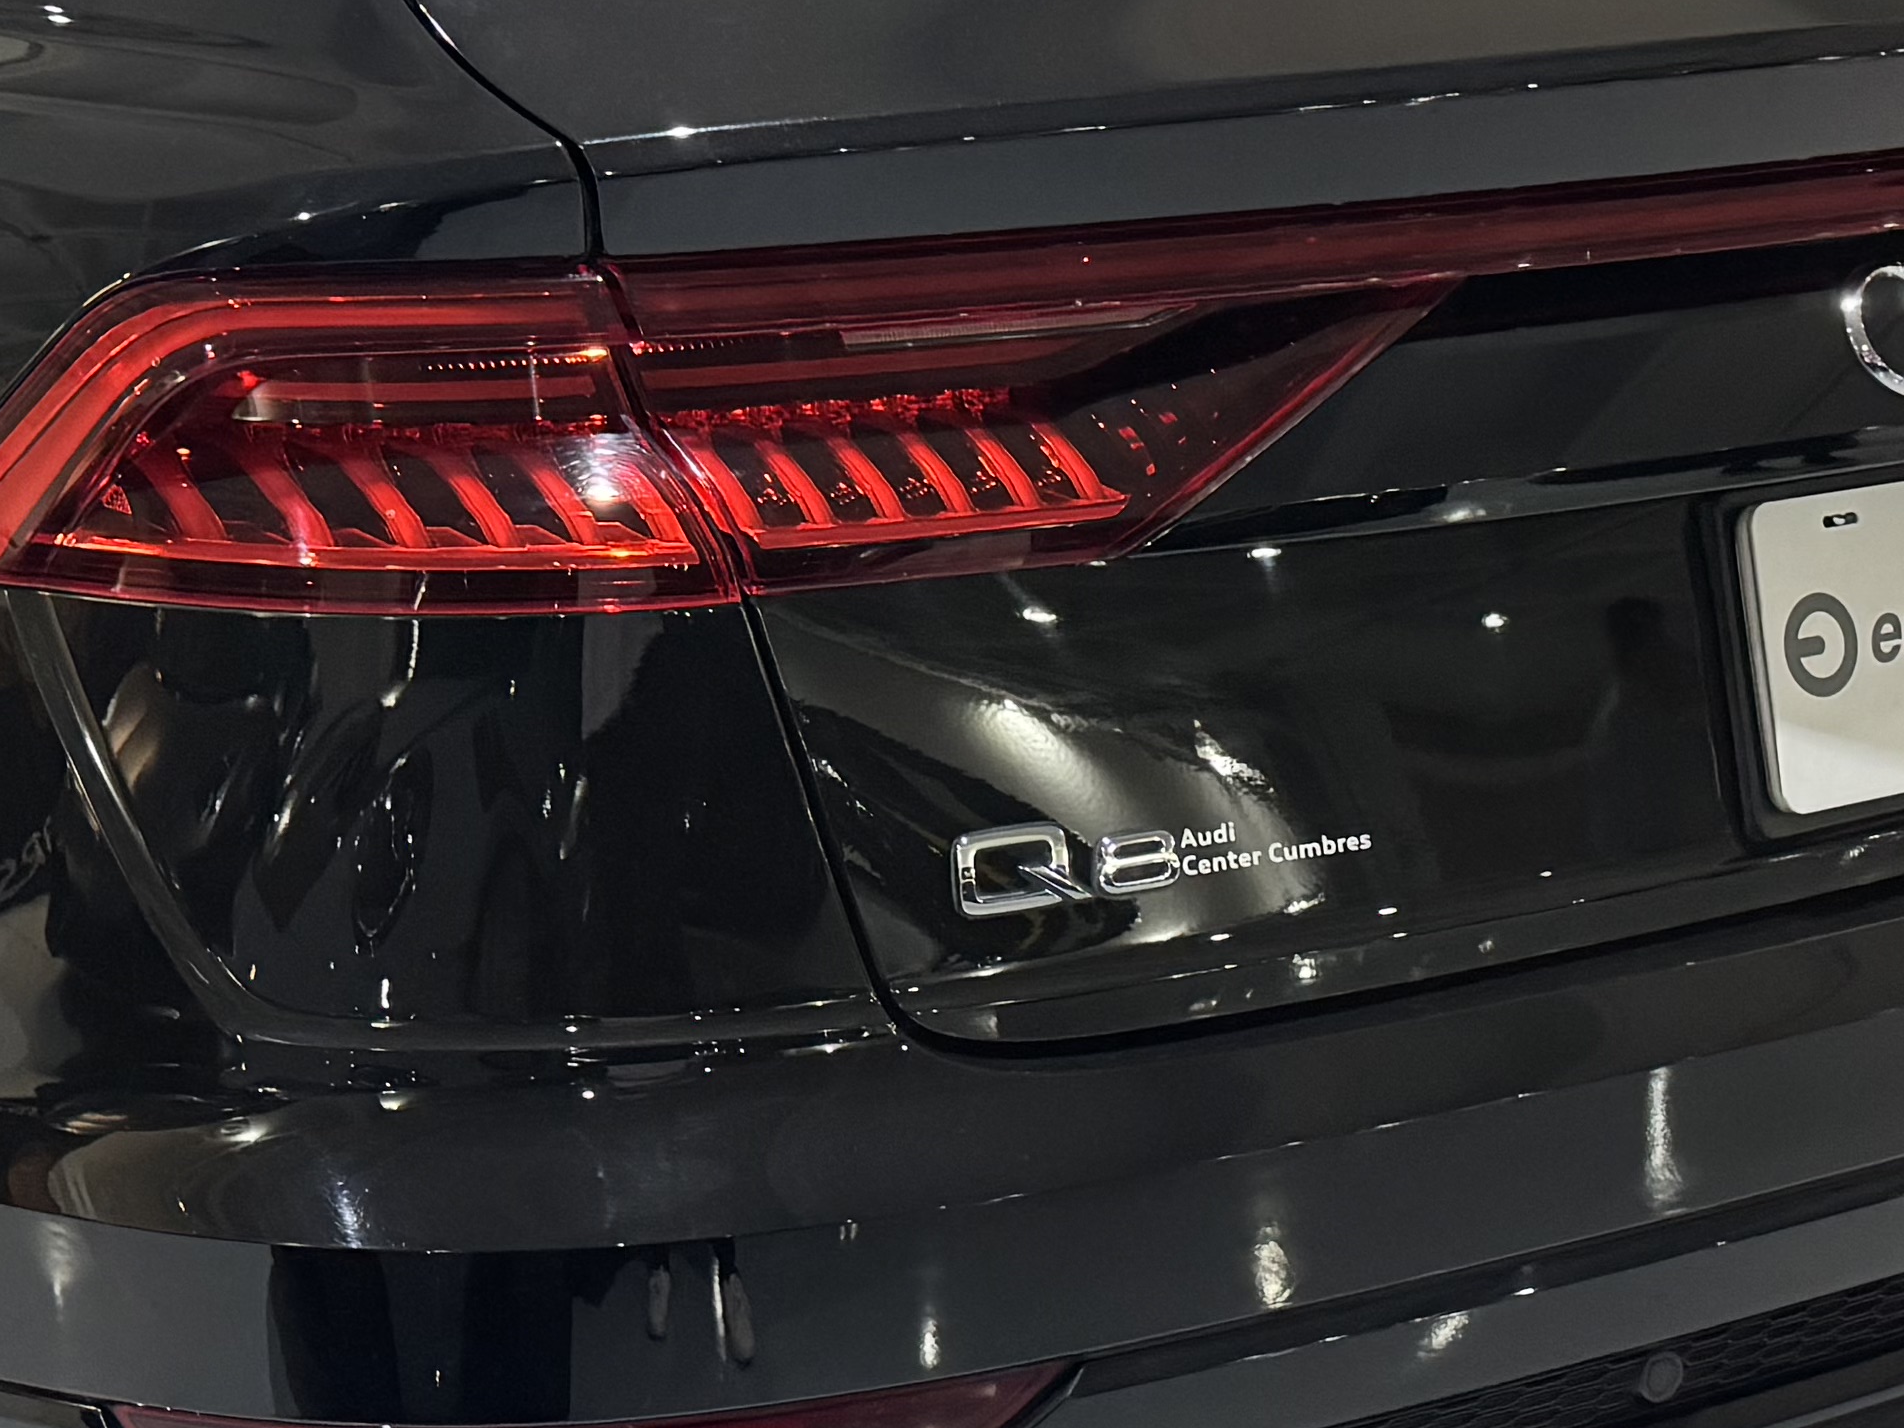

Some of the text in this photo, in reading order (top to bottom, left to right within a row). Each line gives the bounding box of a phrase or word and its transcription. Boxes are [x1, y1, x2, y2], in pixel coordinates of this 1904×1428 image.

[1180, 822, 1237, 849] Audi
[1182, 833, 1372, 876] Center Cumbres
[952, 822, 1181, 920] Q8
